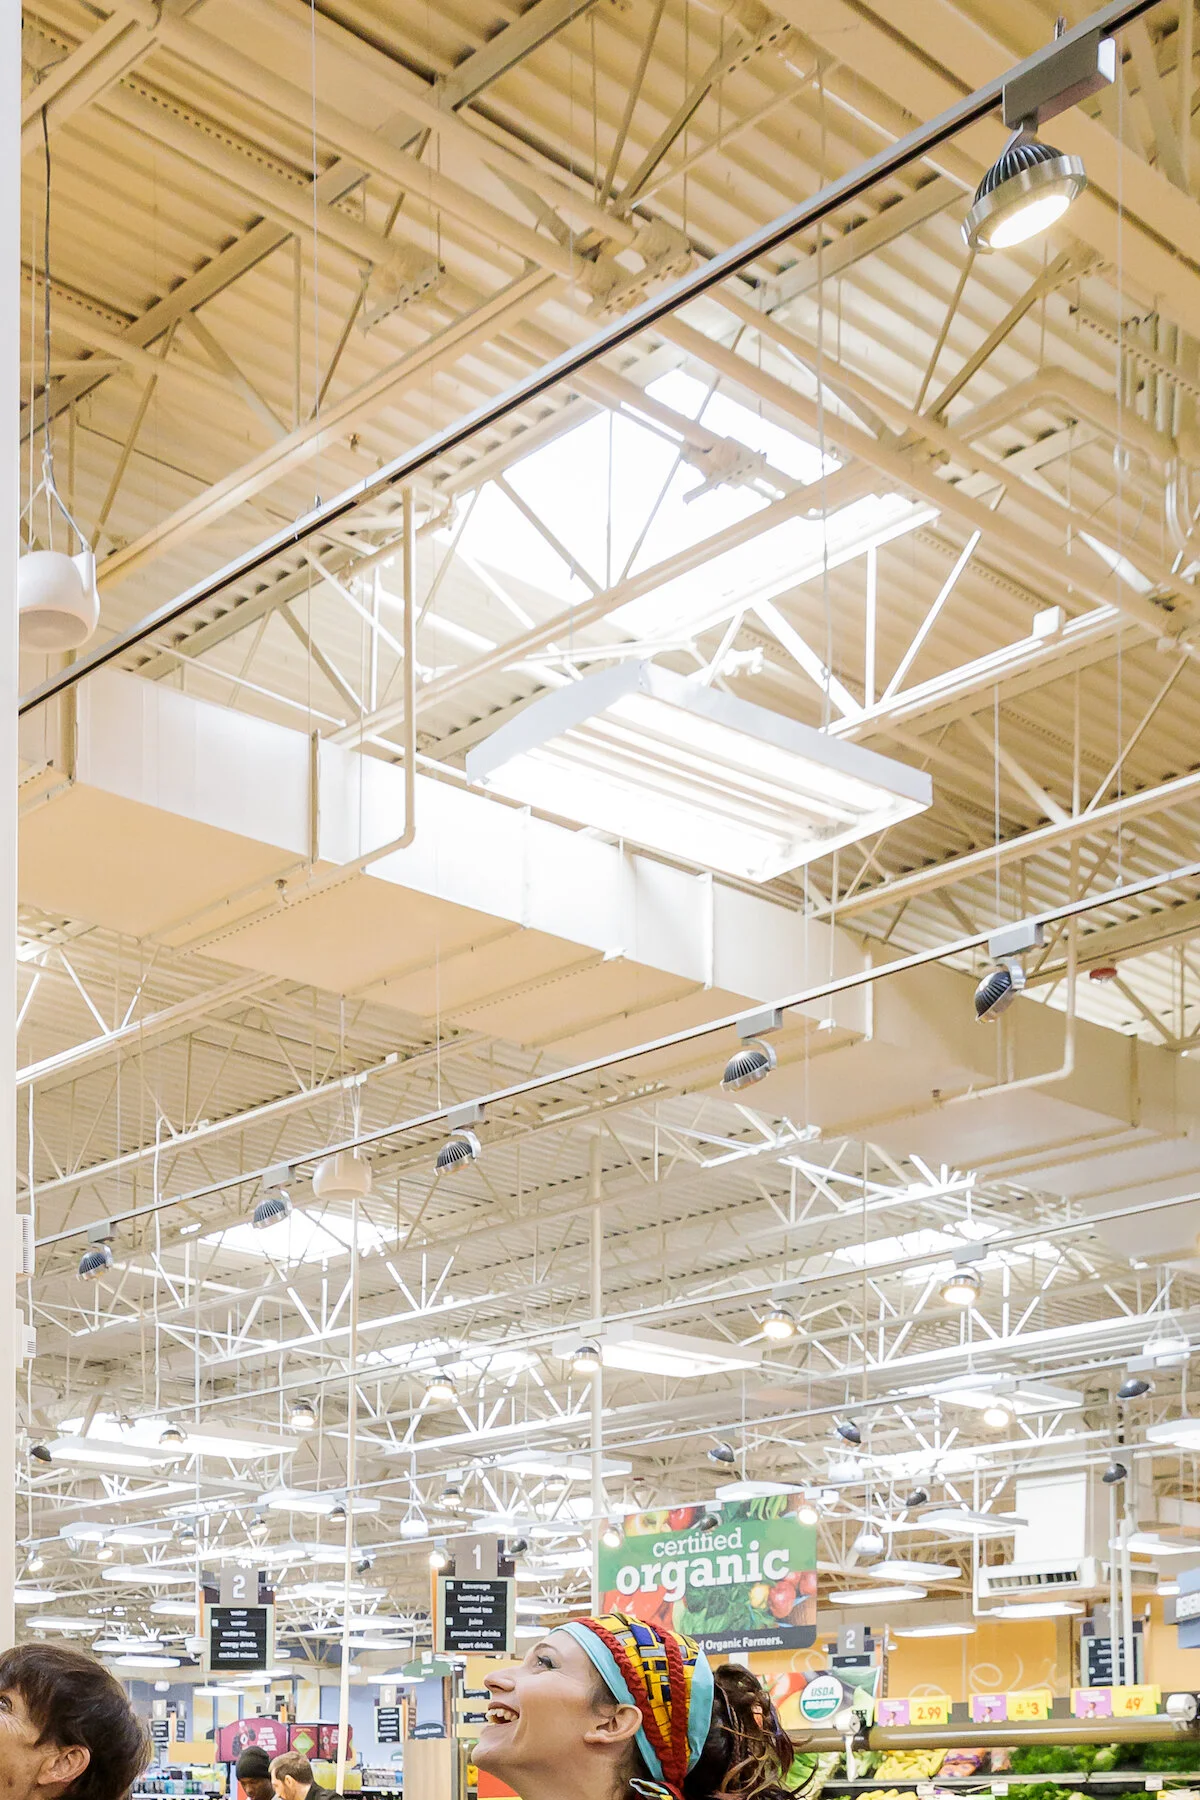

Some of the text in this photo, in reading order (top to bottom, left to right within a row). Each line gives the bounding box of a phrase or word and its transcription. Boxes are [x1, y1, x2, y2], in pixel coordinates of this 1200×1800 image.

[652, 1527, 743, 1558] certified
[472, 1544, 481, 1570] 1
[615, 1540, 790, 1603] organic
[232, 1574, 245, 1598] 2
[705, 1636, 741, 1651] Organic
[811, 1686, 835, 1697] USDA
[917, 1706, 941, 1719] 2.99
